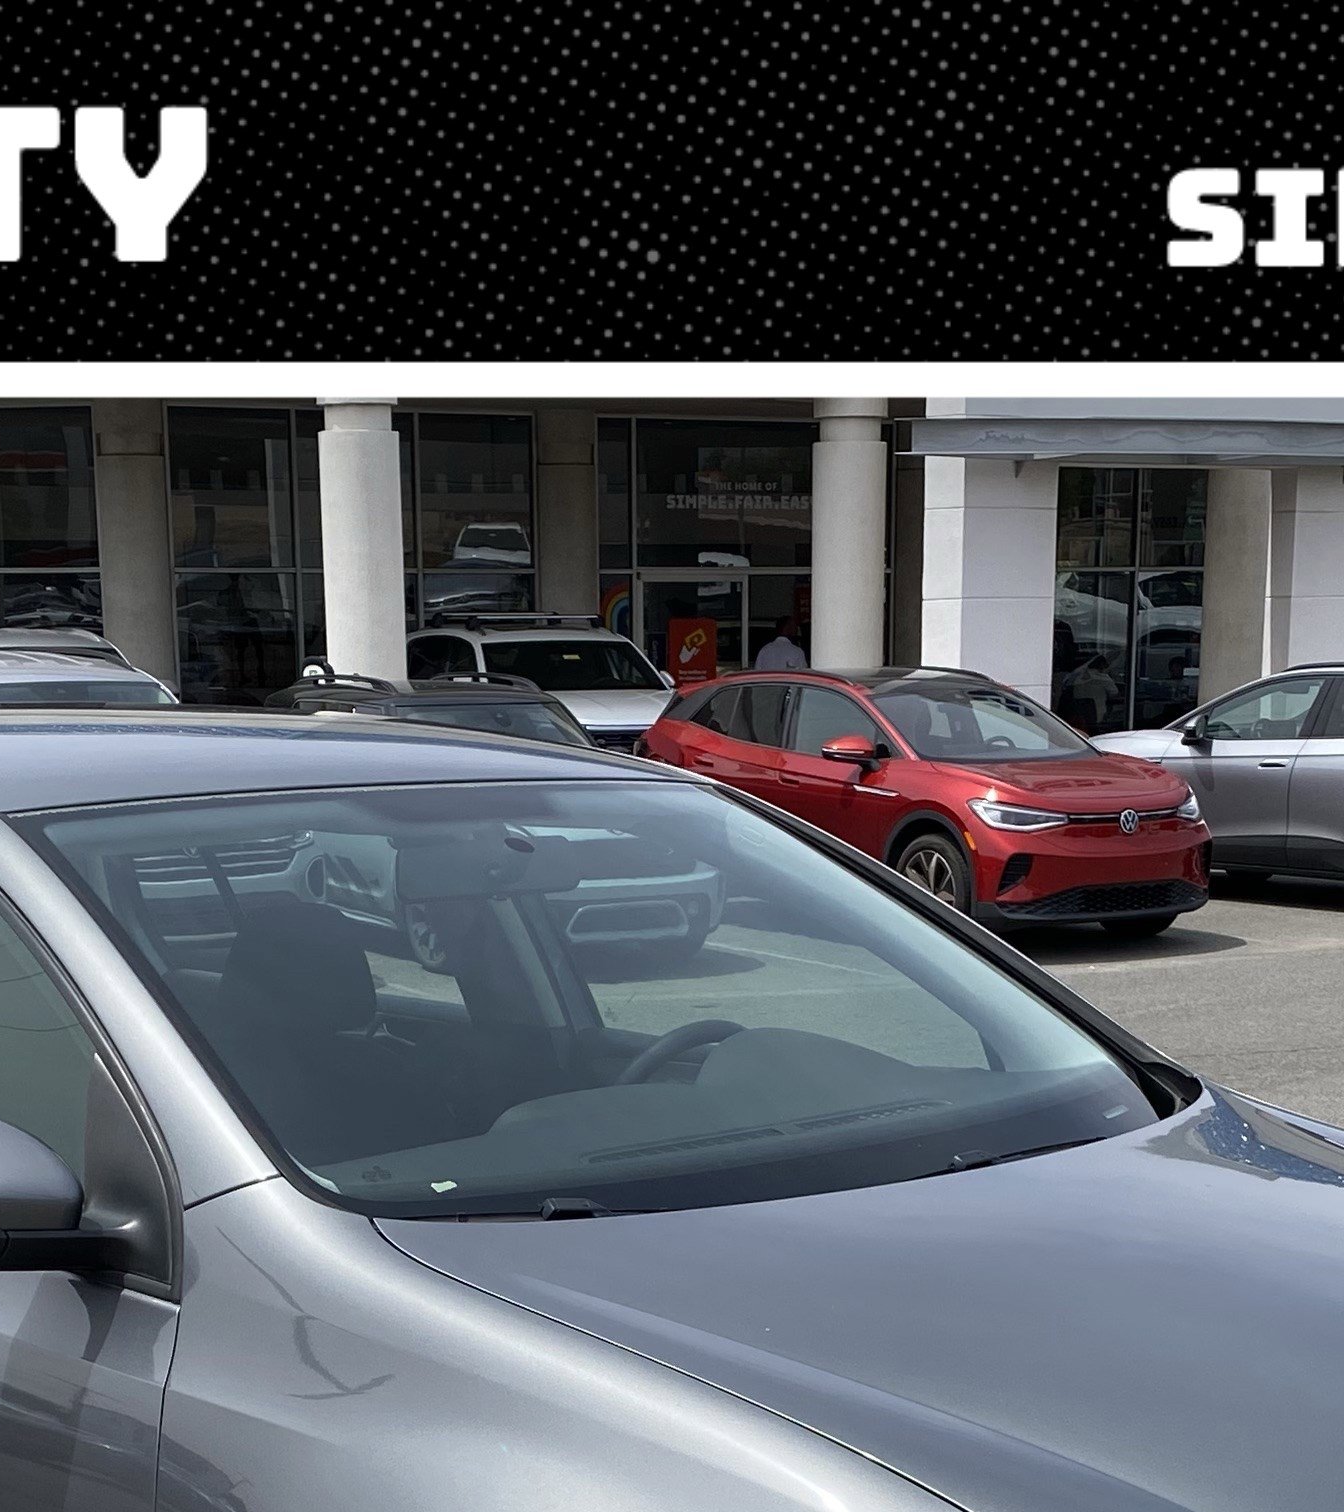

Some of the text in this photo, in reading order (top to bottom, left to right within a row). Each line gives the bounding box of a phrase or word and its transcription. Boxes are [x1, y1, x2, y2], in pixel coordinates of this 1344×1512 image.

[734, 481, 762, 491] HOME
[764, 481, 778, 491] OF
[666, 494, 813, 510] SIMPLE.FAIR.EAS
